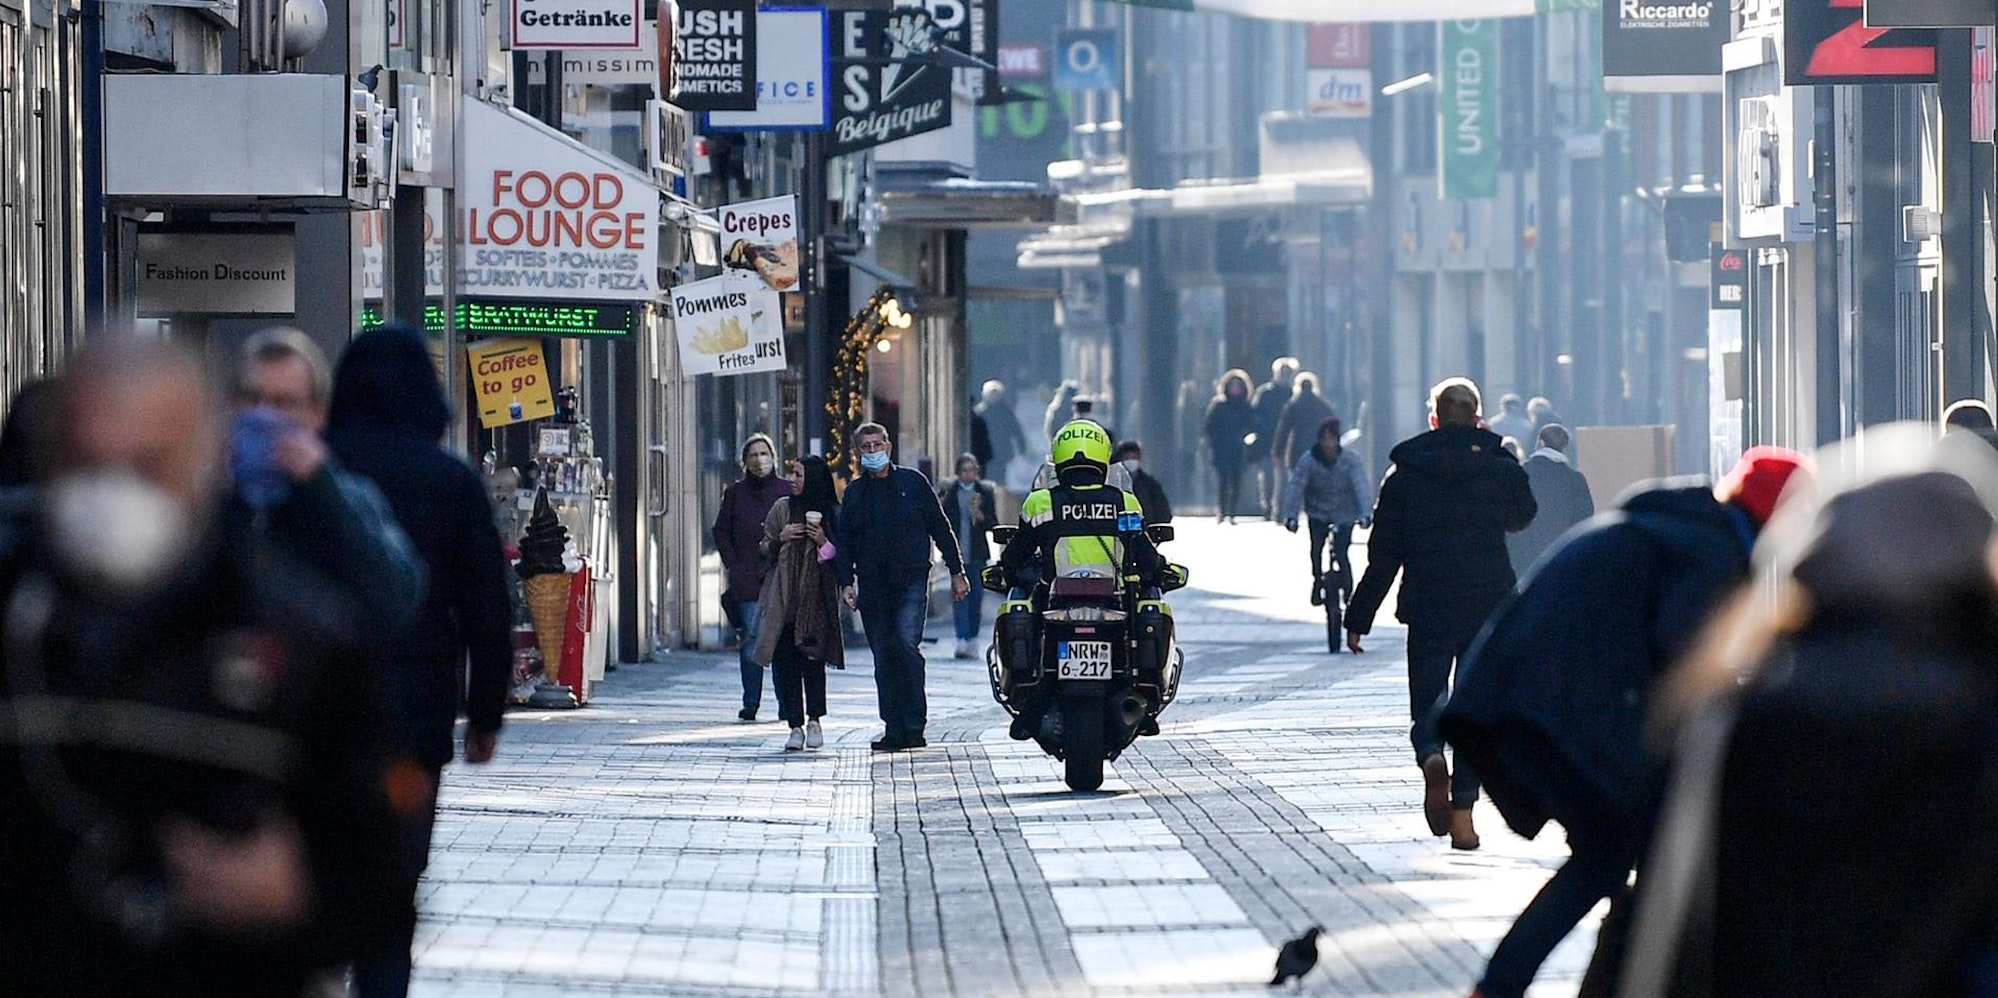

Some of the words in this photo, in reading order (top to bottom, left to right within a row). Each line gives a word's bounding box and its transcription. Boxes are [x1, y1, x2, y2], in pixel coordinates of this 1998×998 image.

[520, 10, 632, 27] Getränke
[1319, 76, 1362, 99] dm
[1456, 47, 1482, 155] UNITED
[836, 99, 943, 143] Belgique
[493, 170, 623, 210] FOOD
[469, 208, 645, 250] LOUNGE
[475, 249, 547, 268] SOFTEIS
[558, 252, 639, 271] POMMES
[145, 263, 209, 281] Fashion
[214, 263, 286, 281] Discount
[597, 273, 649, 292] PIZZA
[469, 303, 598, 328] BRATWURST
[675, 293, 748, 318] Pommes
[476, 353, 539, 377] Coffee
[718, 353, 757, 371] Frites
[482, 379, 503, 396] to
[511, 373, 537, 394] go
[1057, 428, 1104, 446] POLIZEI
[1062, 503, 1118, 520] POLIZEI
[1068, 643, 1099, 660] NRW
[1061, 661, 1109, 677] 6-217
